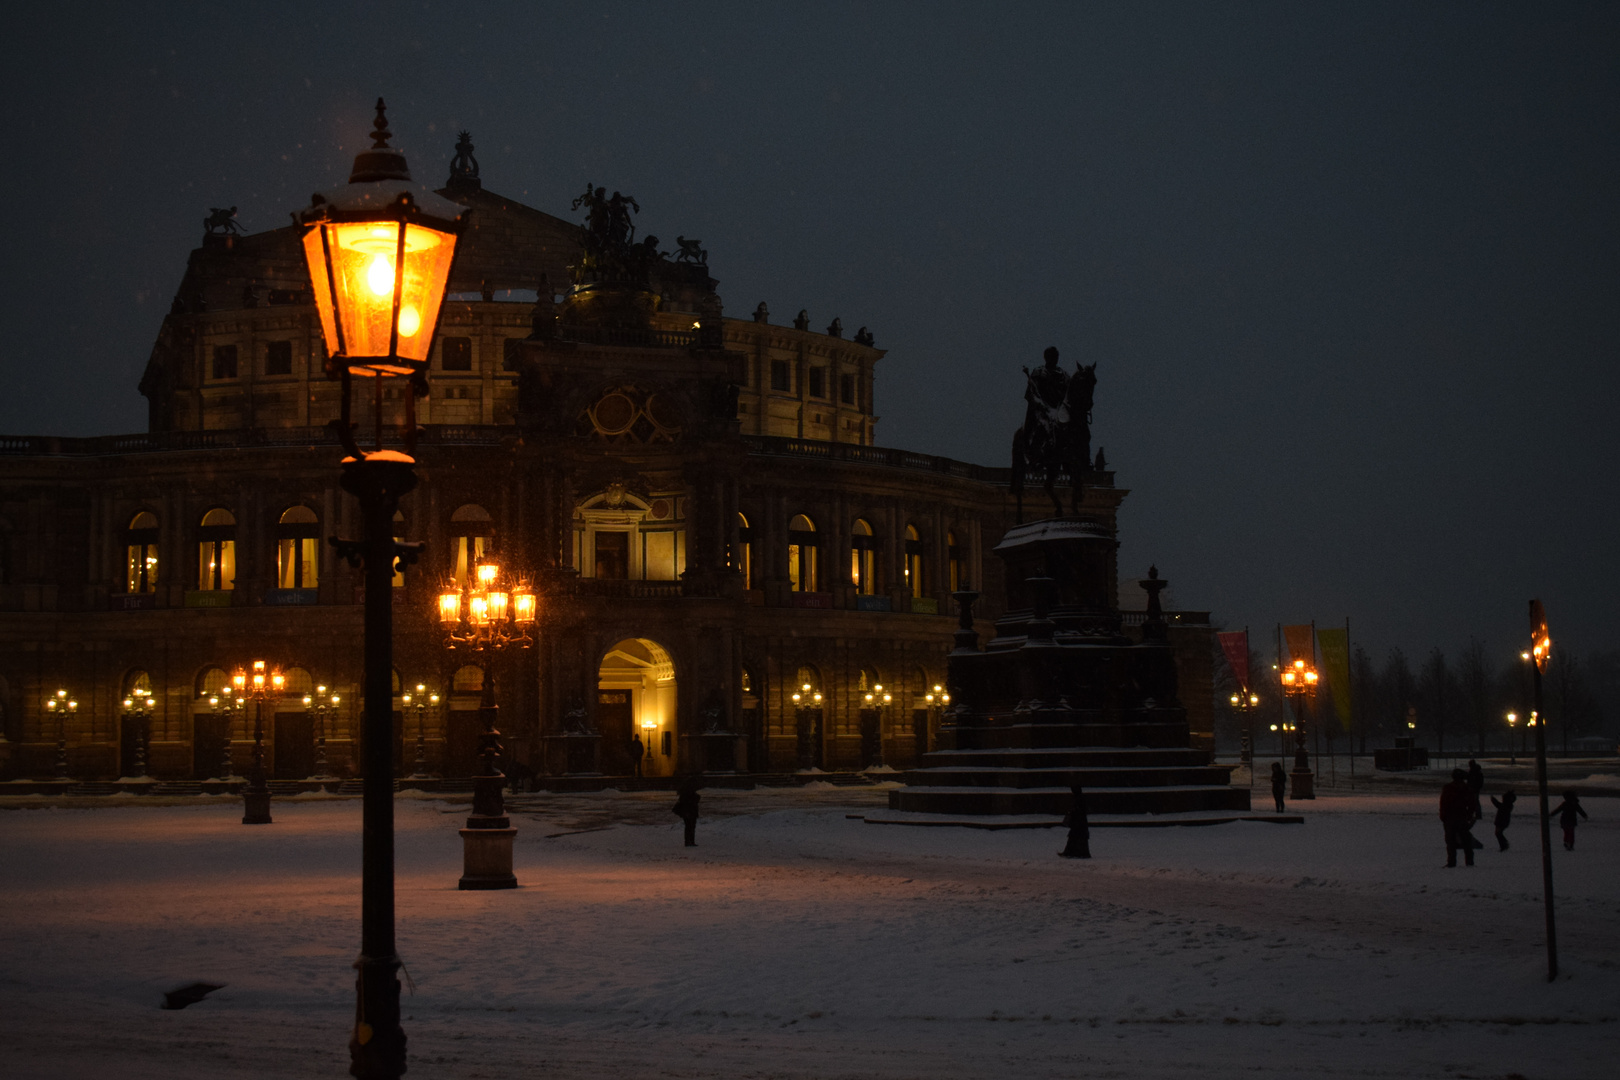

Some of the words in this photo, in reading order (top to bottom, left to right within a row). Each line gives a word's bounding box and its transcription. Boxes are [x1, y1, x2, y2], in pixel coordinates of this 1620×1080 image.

[124, 597, 142, 609] Für
[199, 595, 216, 606] ein
[277, 592, 304, 604] welt-
[805, 596, 820, 607] ein
